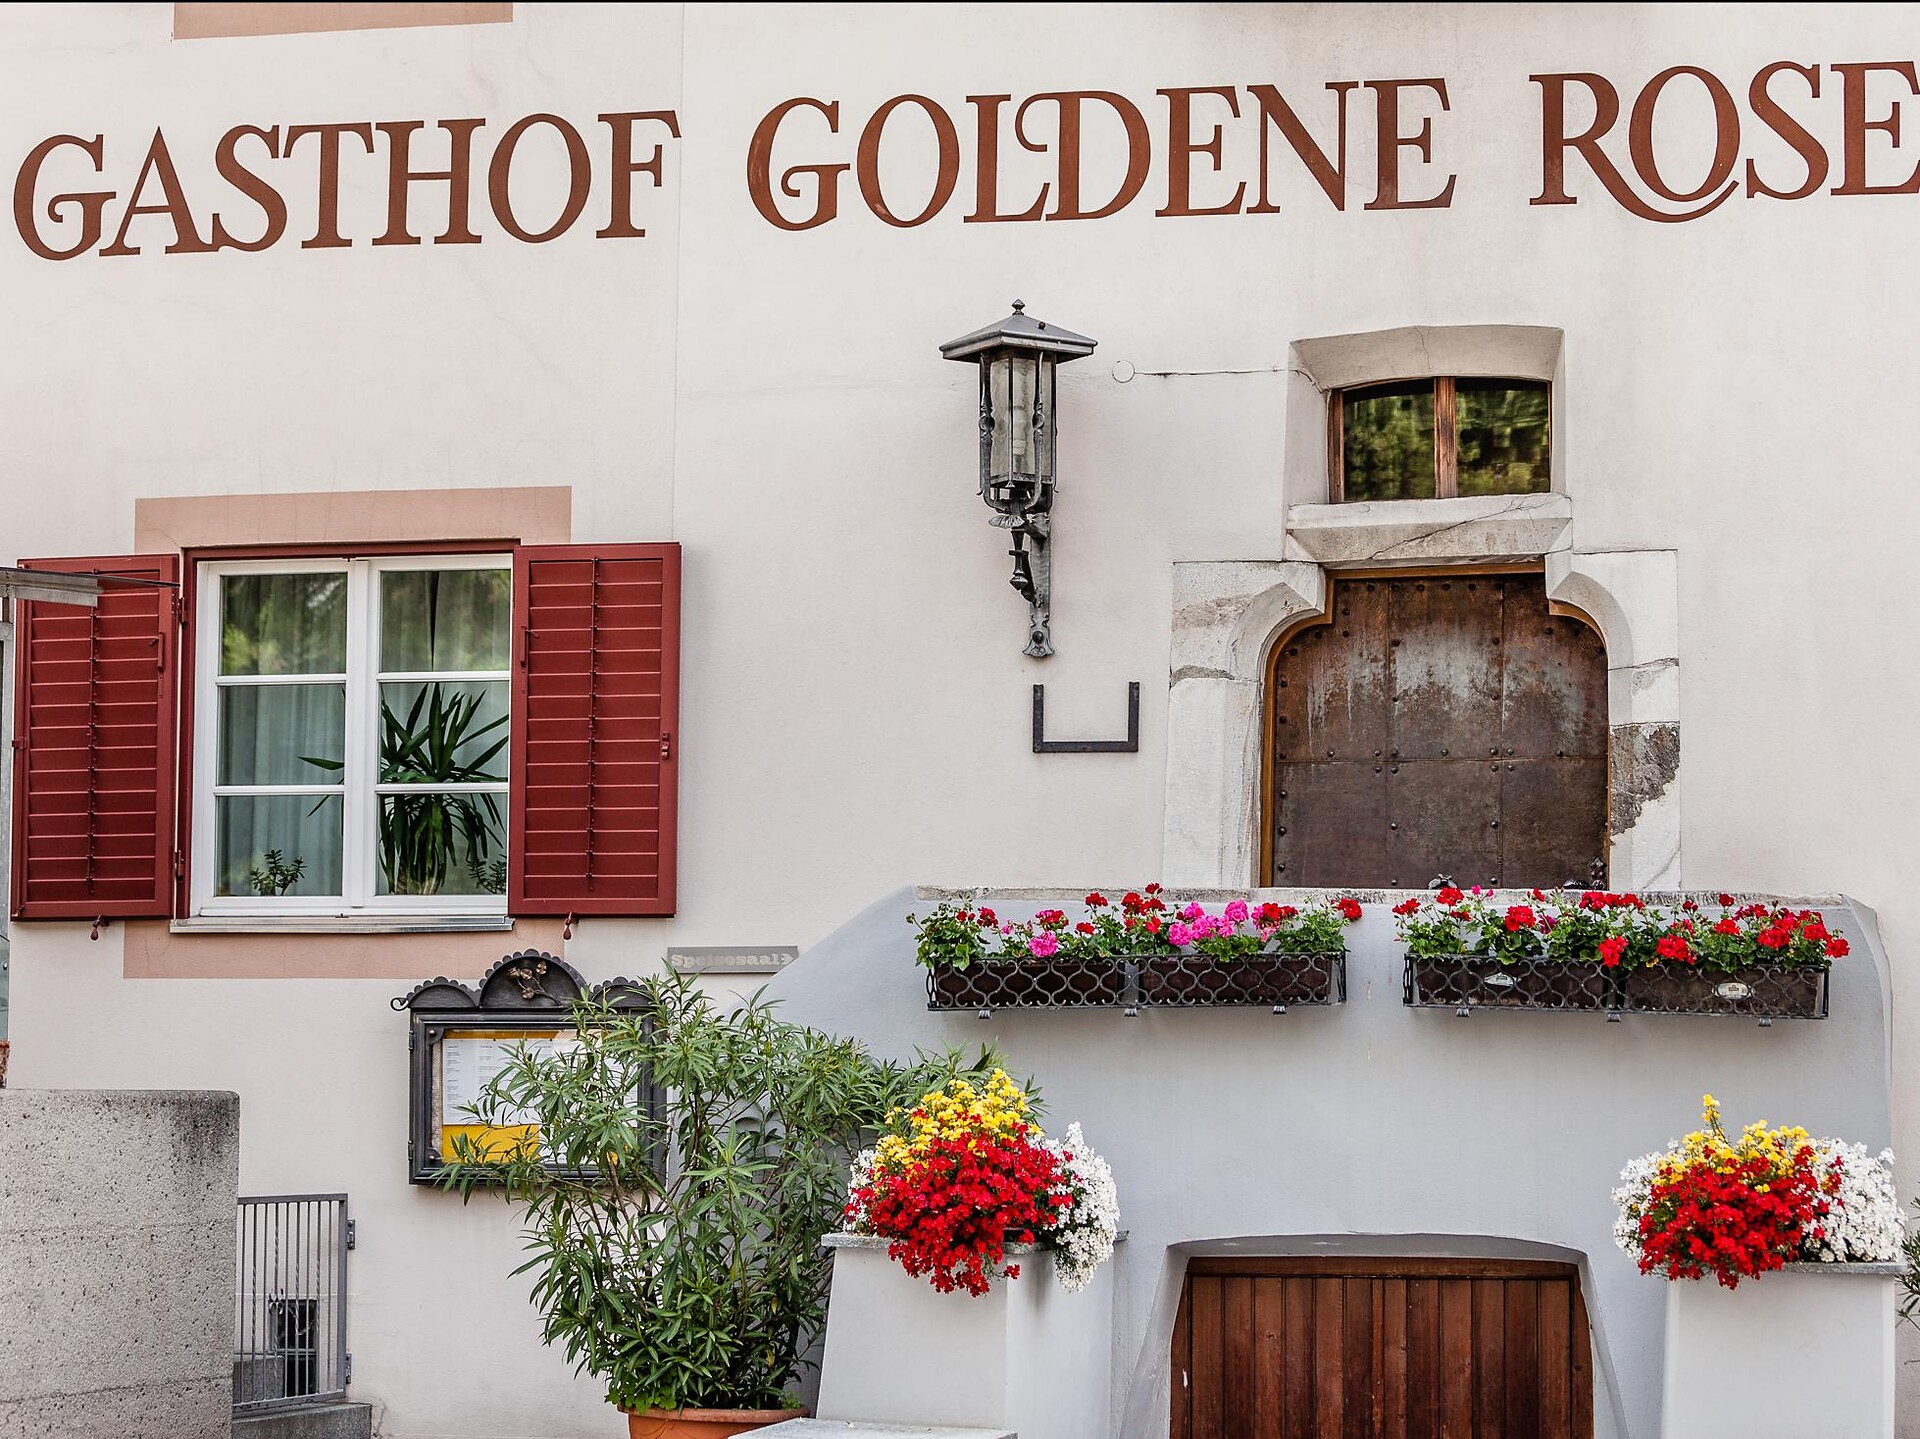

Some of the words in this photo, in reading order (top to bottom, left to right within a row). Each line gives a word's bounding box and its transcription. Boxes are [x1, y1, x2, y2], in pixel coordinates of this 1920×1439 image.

[13, 110, 681, 261] GASTHOF
[747, 78, 1456, 232] GOLDENE
[1529, 61, 1920, 223] ROSE
[671, 953, 781, 968] Speisesaal
